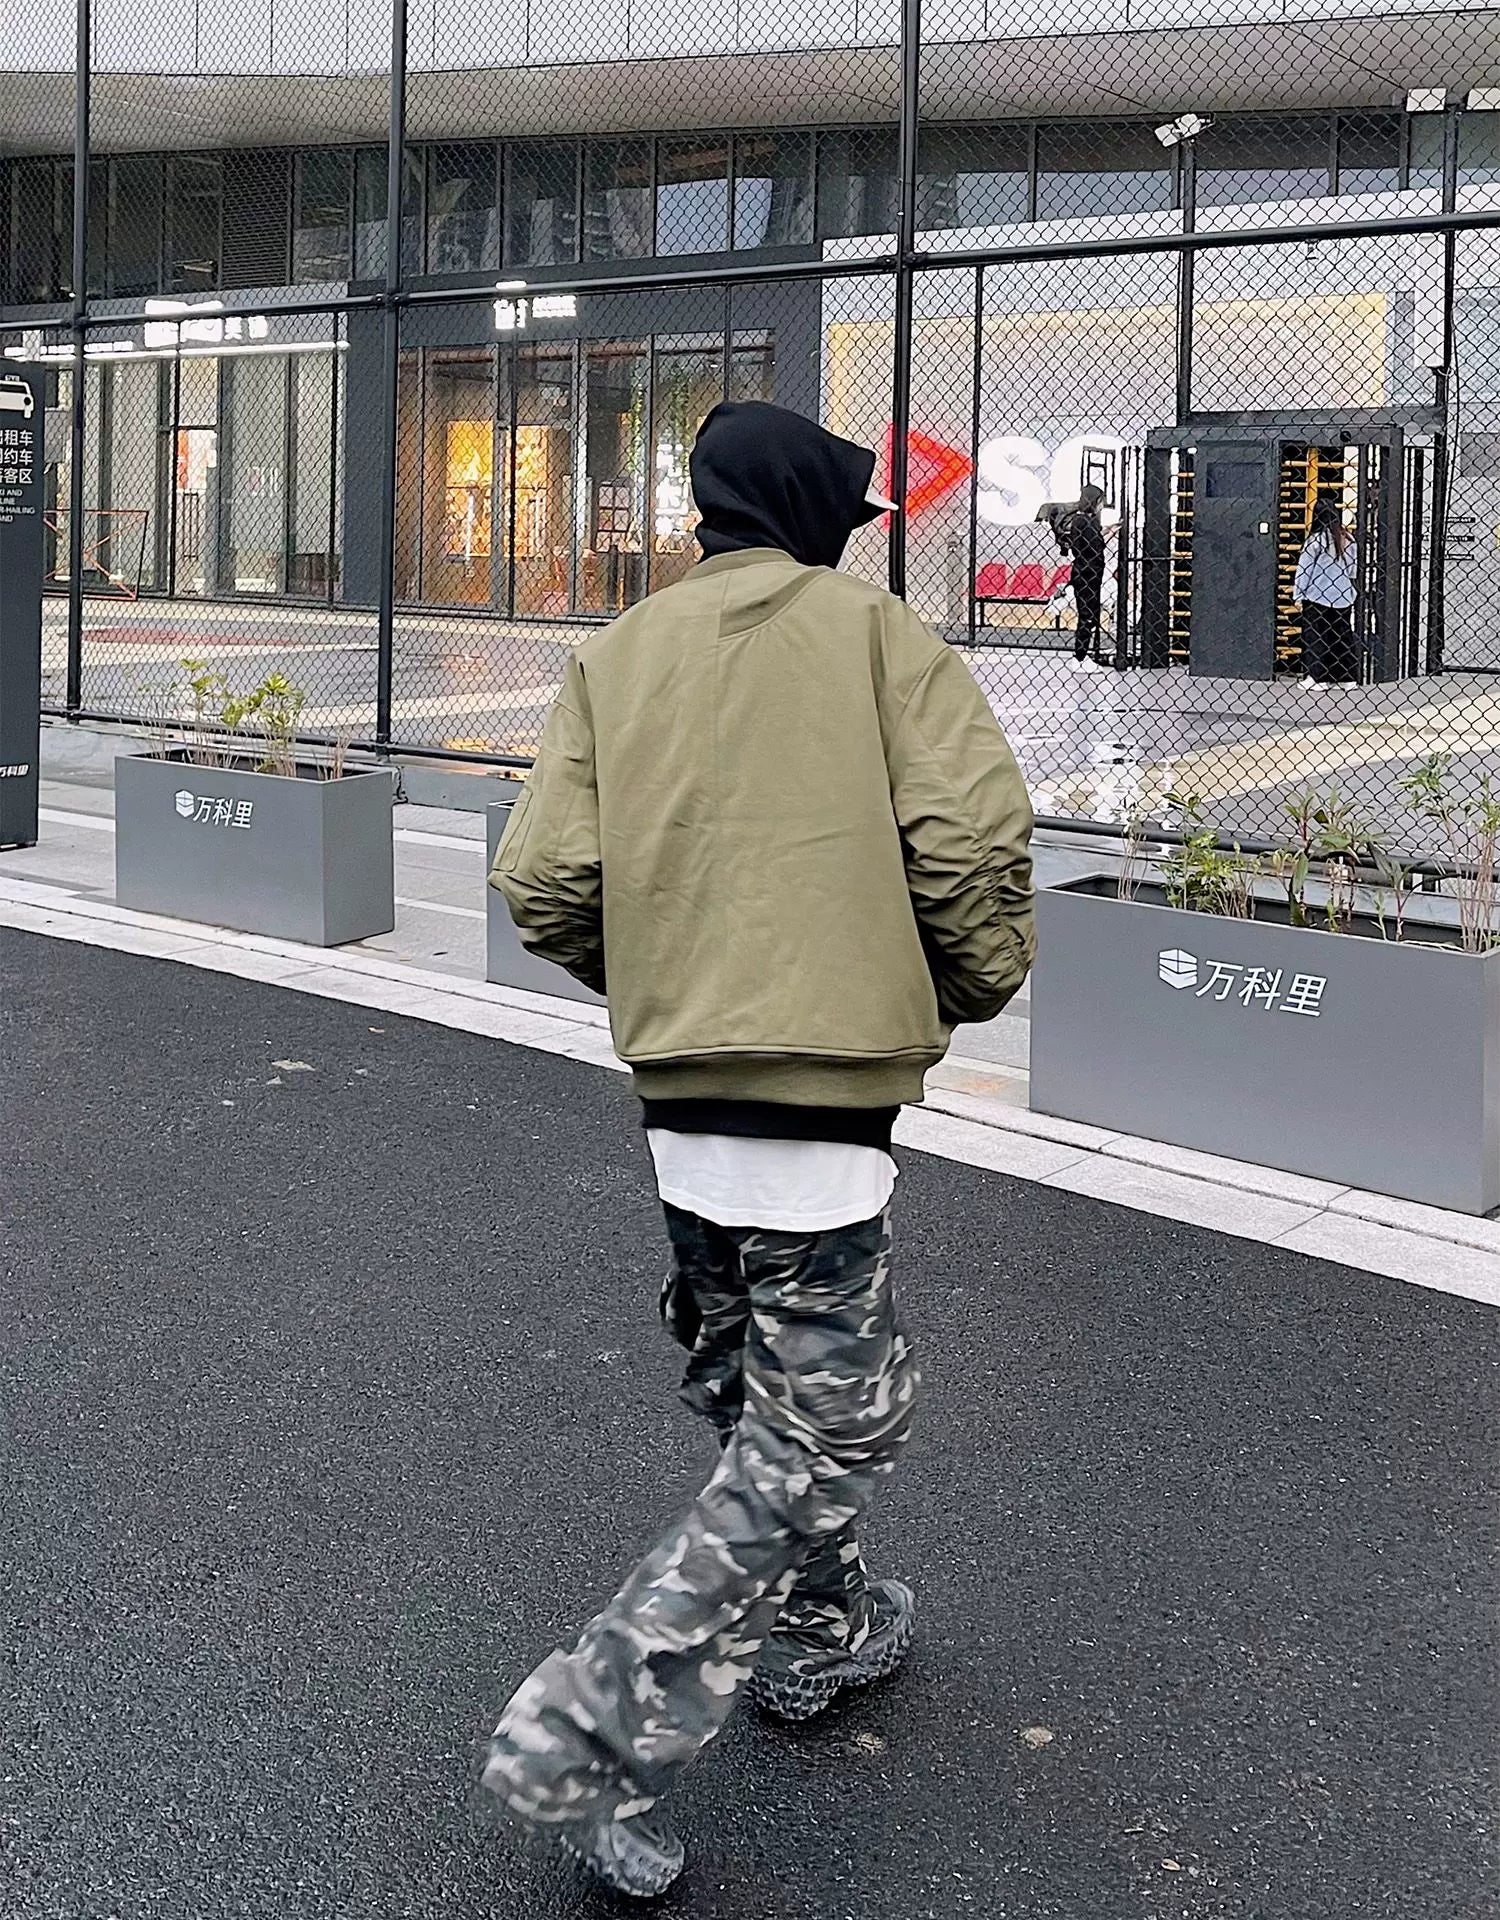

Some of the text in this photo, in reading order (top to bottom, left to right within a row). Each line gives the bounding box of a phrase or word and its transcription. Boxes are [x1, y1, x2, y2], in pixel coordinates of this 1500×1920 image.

[0, 430, 33, 446] 租车
[0, 448, 33, 465] 约车
[0, 467, 33, 484] 客区
[193, 796, 253, 829] 万科里
[1195, 960, 1327, 1016] 万科里
